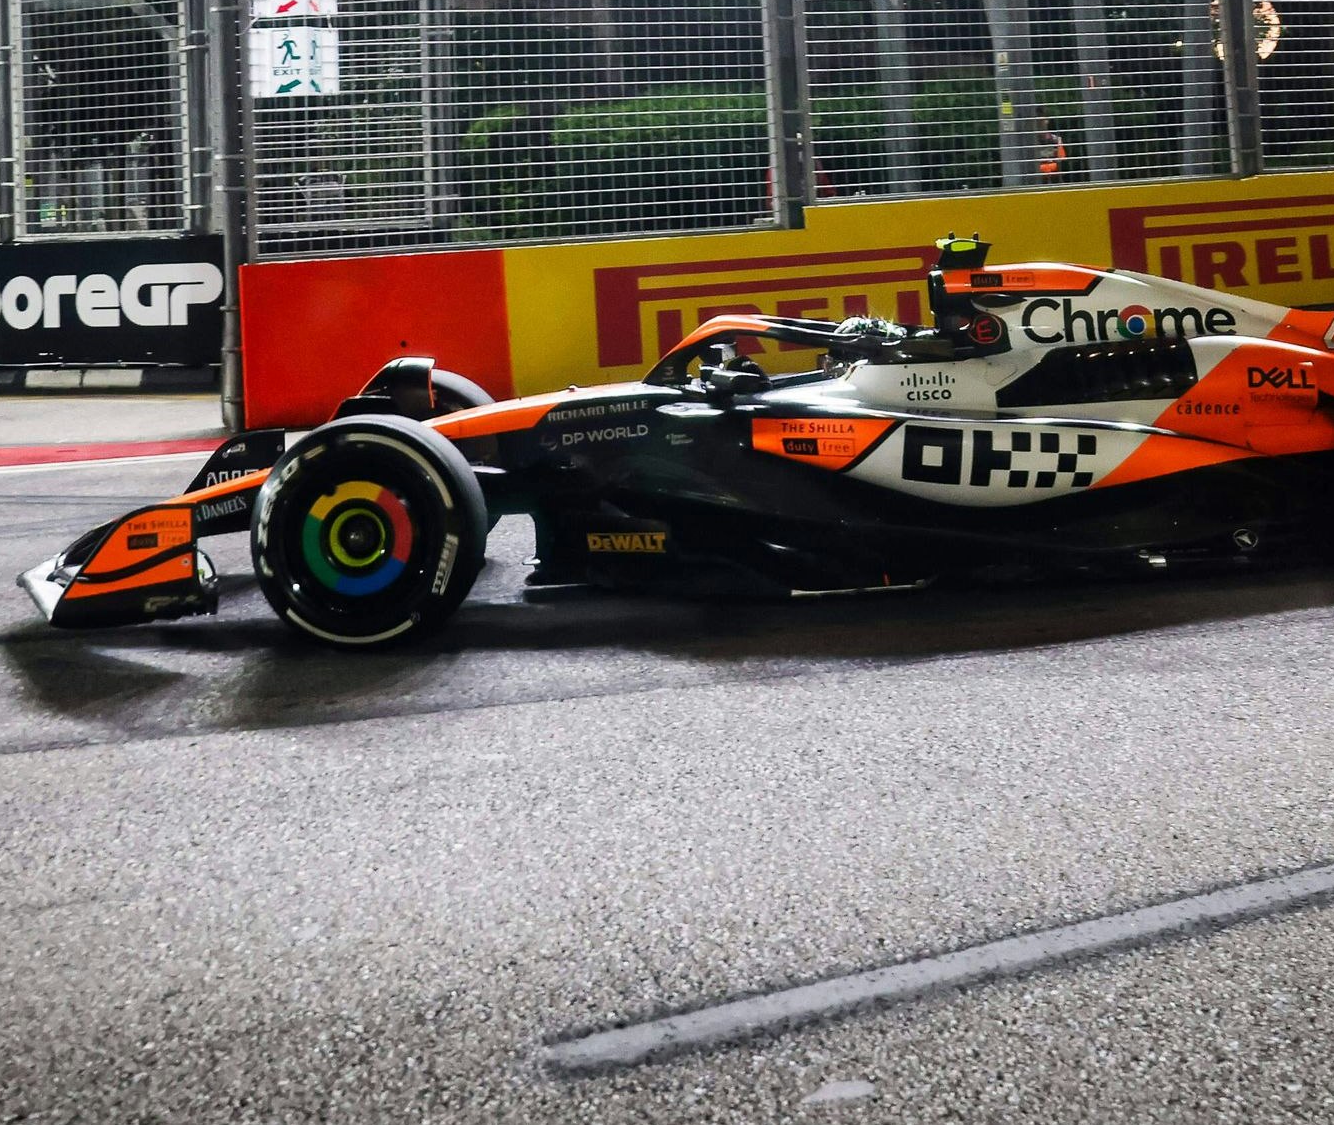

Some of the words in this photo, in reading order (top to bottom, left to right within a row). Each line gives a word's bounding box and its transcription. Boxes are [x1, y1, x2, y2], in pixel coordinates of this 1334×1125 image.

[1022, 298, 1237, 343] Chrome
[1247, 367, 1315, 389] DELL
[548, 405, 605, 422] RICHARD
[609, 400, 649, 414] MILLE
[562, 432, 584, 446] DP
[587, 424, 649, 442] WORLD
[781, 423, 804, 433] THE
[809, 422, 855, 434] SHILLA
[786, 439, 814, 453] duty
[822, 440, 851, 453] free
[902, 425, 1096, 488] OKX
